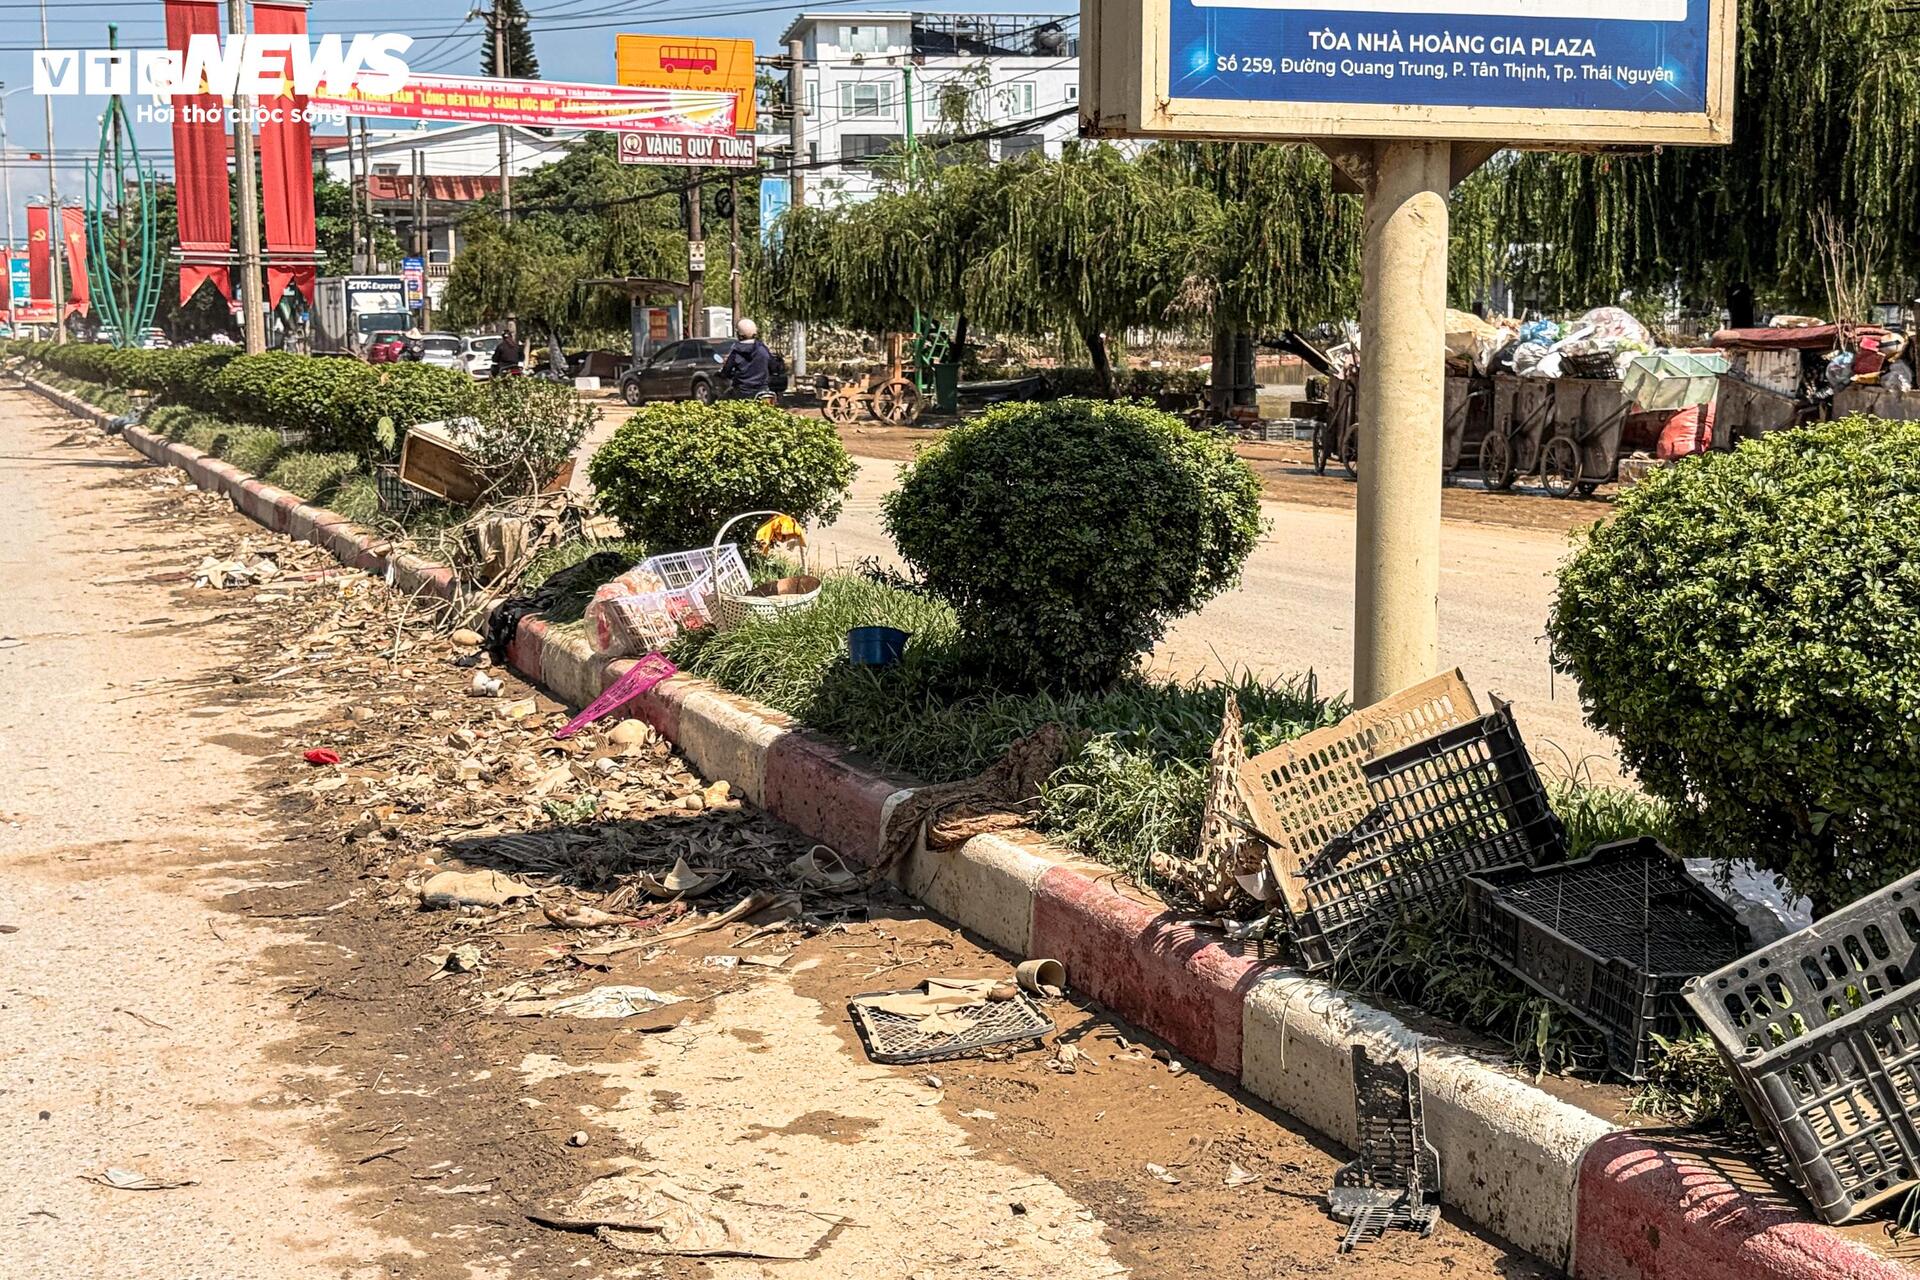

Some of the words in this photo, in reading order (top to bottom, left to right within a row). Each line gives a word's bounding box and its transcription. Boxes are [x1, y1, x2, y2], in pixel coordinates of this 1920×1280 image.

[1308, 27, 1352, 50] TÒA
[1357, 30, 1404, 53] NHÀ
[1409, 30, 1485, 55] HOÀNG
[1489, 36, 1526, 56] GIA
[1531, 38, 1597, 57] PLAZA
[1216, 54, 1238, 72] Số
[1242, 57, 1276, 75] 259,
[1281, 57, 1336, 77] Đường
[1340, 59, 1395, 78] Quang
[1399, 61, 1448, 79] Trung,
[1452, 62, 1467, 77] P.
[1470, 62, 1499, 77] Tân
[1503, 63, 1551, 82] Thịnh,
[1554, 65, 1577, 82] Tp.
[1581, 64, 1612, 81] Thái
[1616, 65, 1674, 84] Nguyên
[645, 134, 682, 155] VÀNG
[372, 282, 402, 291] Express
